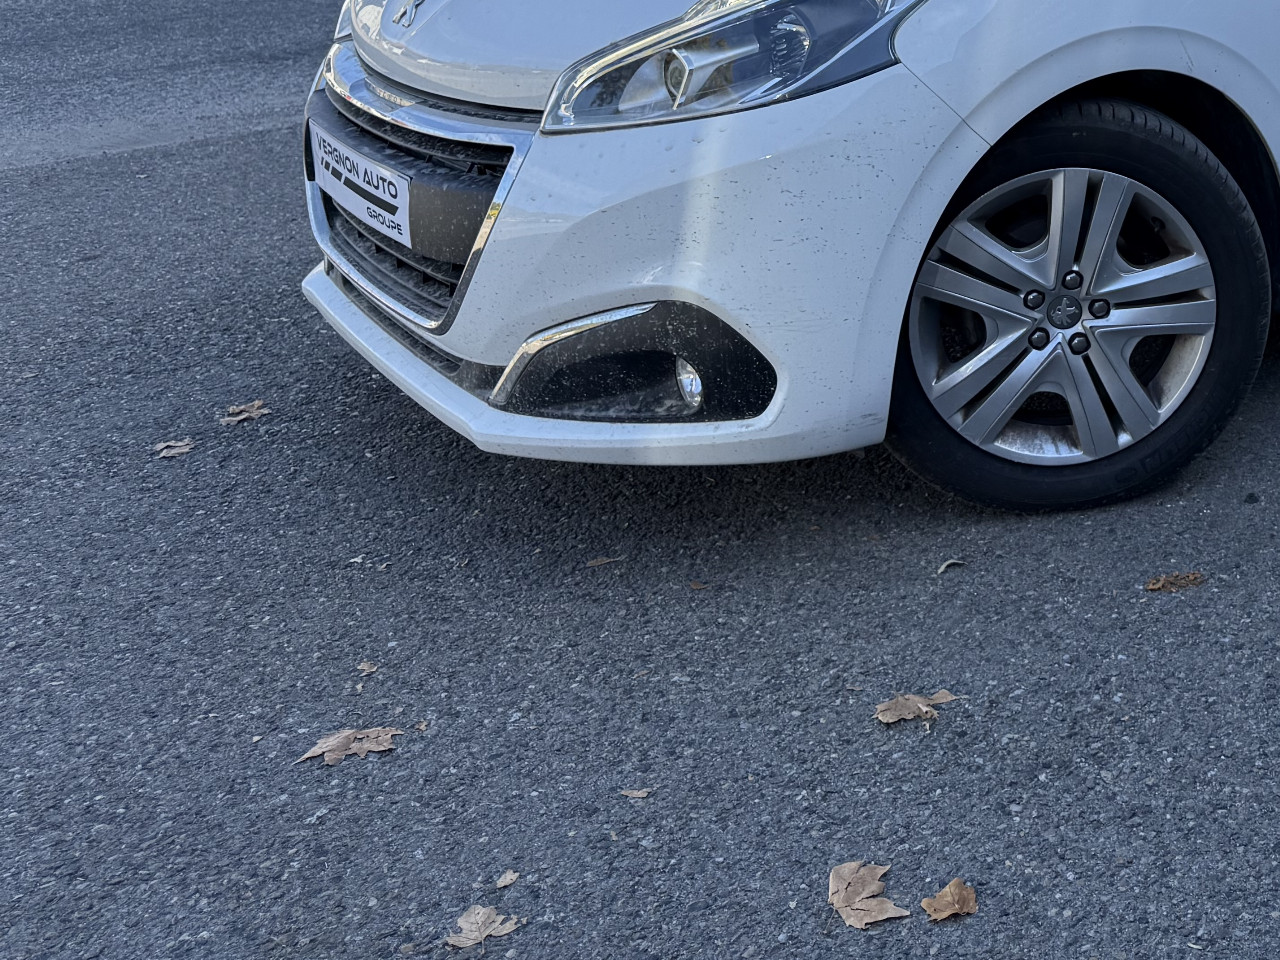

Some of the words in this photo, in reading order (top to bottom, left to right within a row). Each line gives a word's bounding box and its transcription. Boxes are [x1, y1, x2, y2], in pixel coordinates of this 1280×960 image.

[315, 131, 360, 179] VERGNON
[362, 167, 398, 199] AUTO
[366, 206, 403, 236] GROUPE
